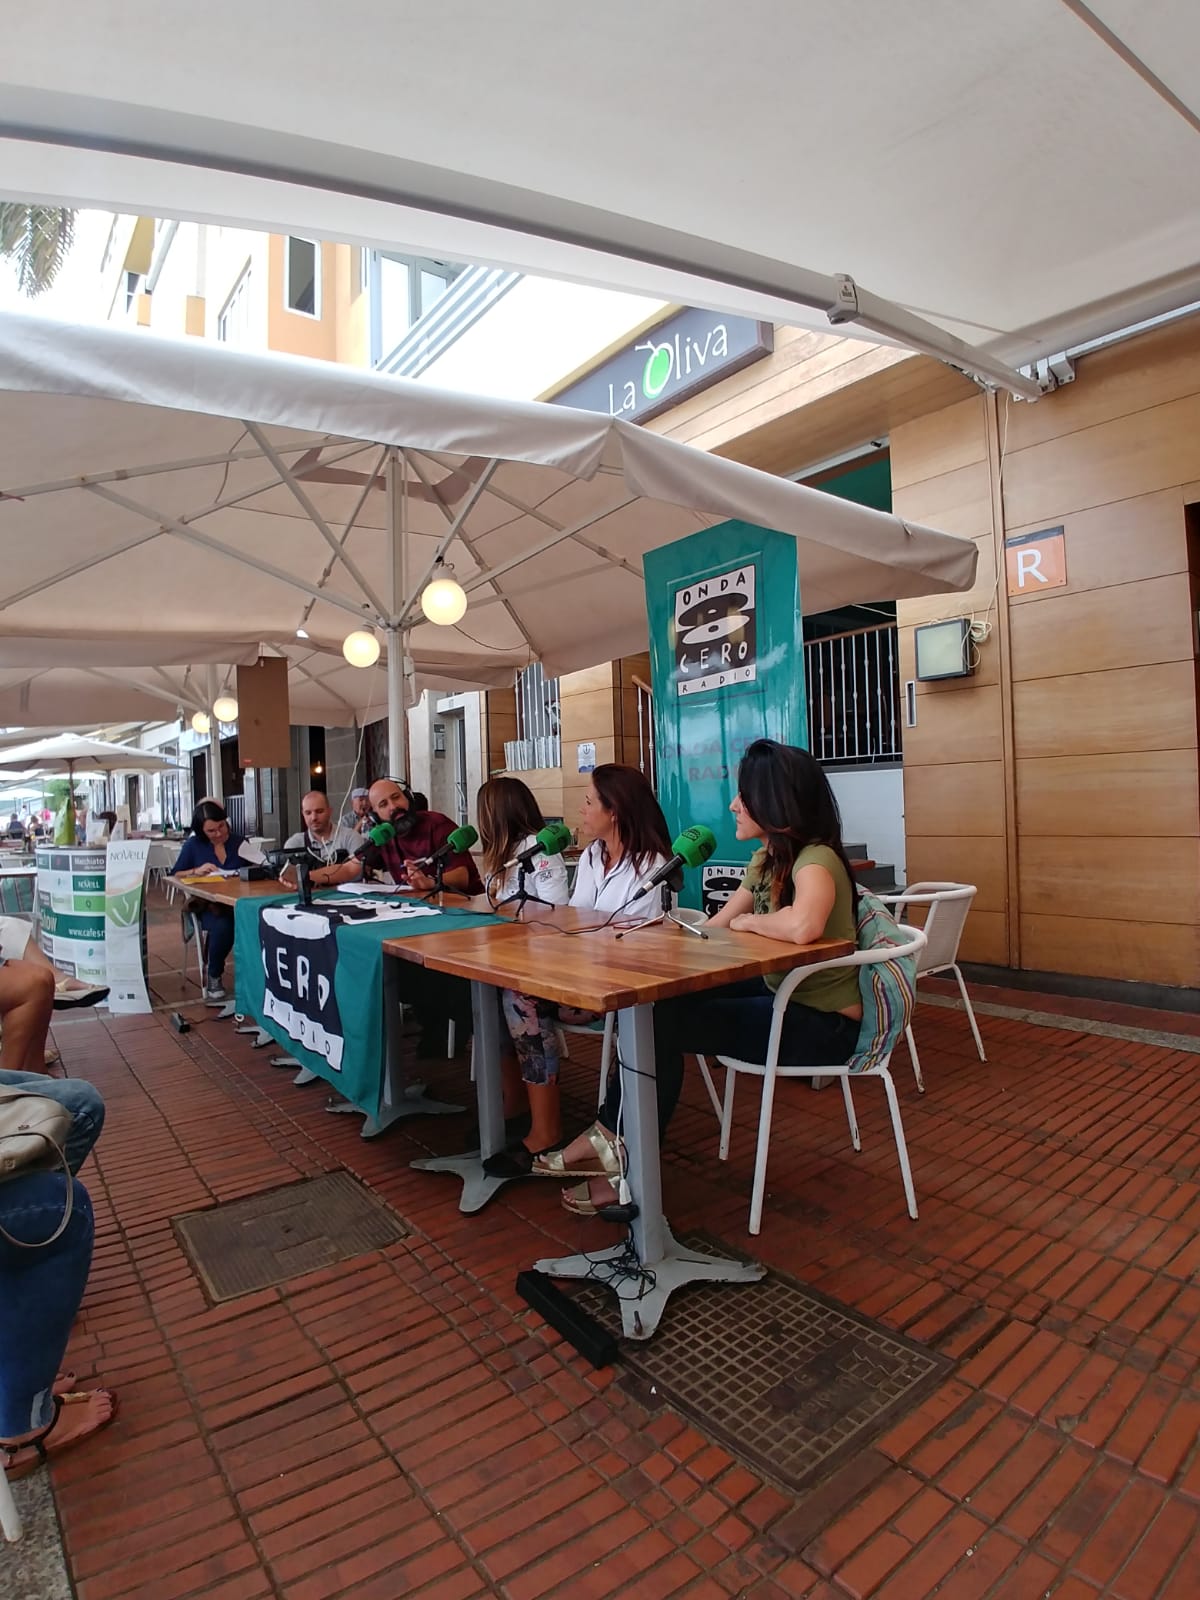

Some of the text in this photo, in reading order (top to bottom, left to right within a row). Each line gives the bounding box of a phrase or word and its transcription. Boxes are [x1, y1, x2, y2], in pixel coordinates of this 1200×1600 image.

[607, 323, 729, 417] La Oliva
[1017, 548, 1050, 589] R
[682, 571, 747, 606] ONDA
[679, 640, 749, 674] CERO
[682, 668, 751, 693] RADIO
[707, 867, 746, 877] ONDA
